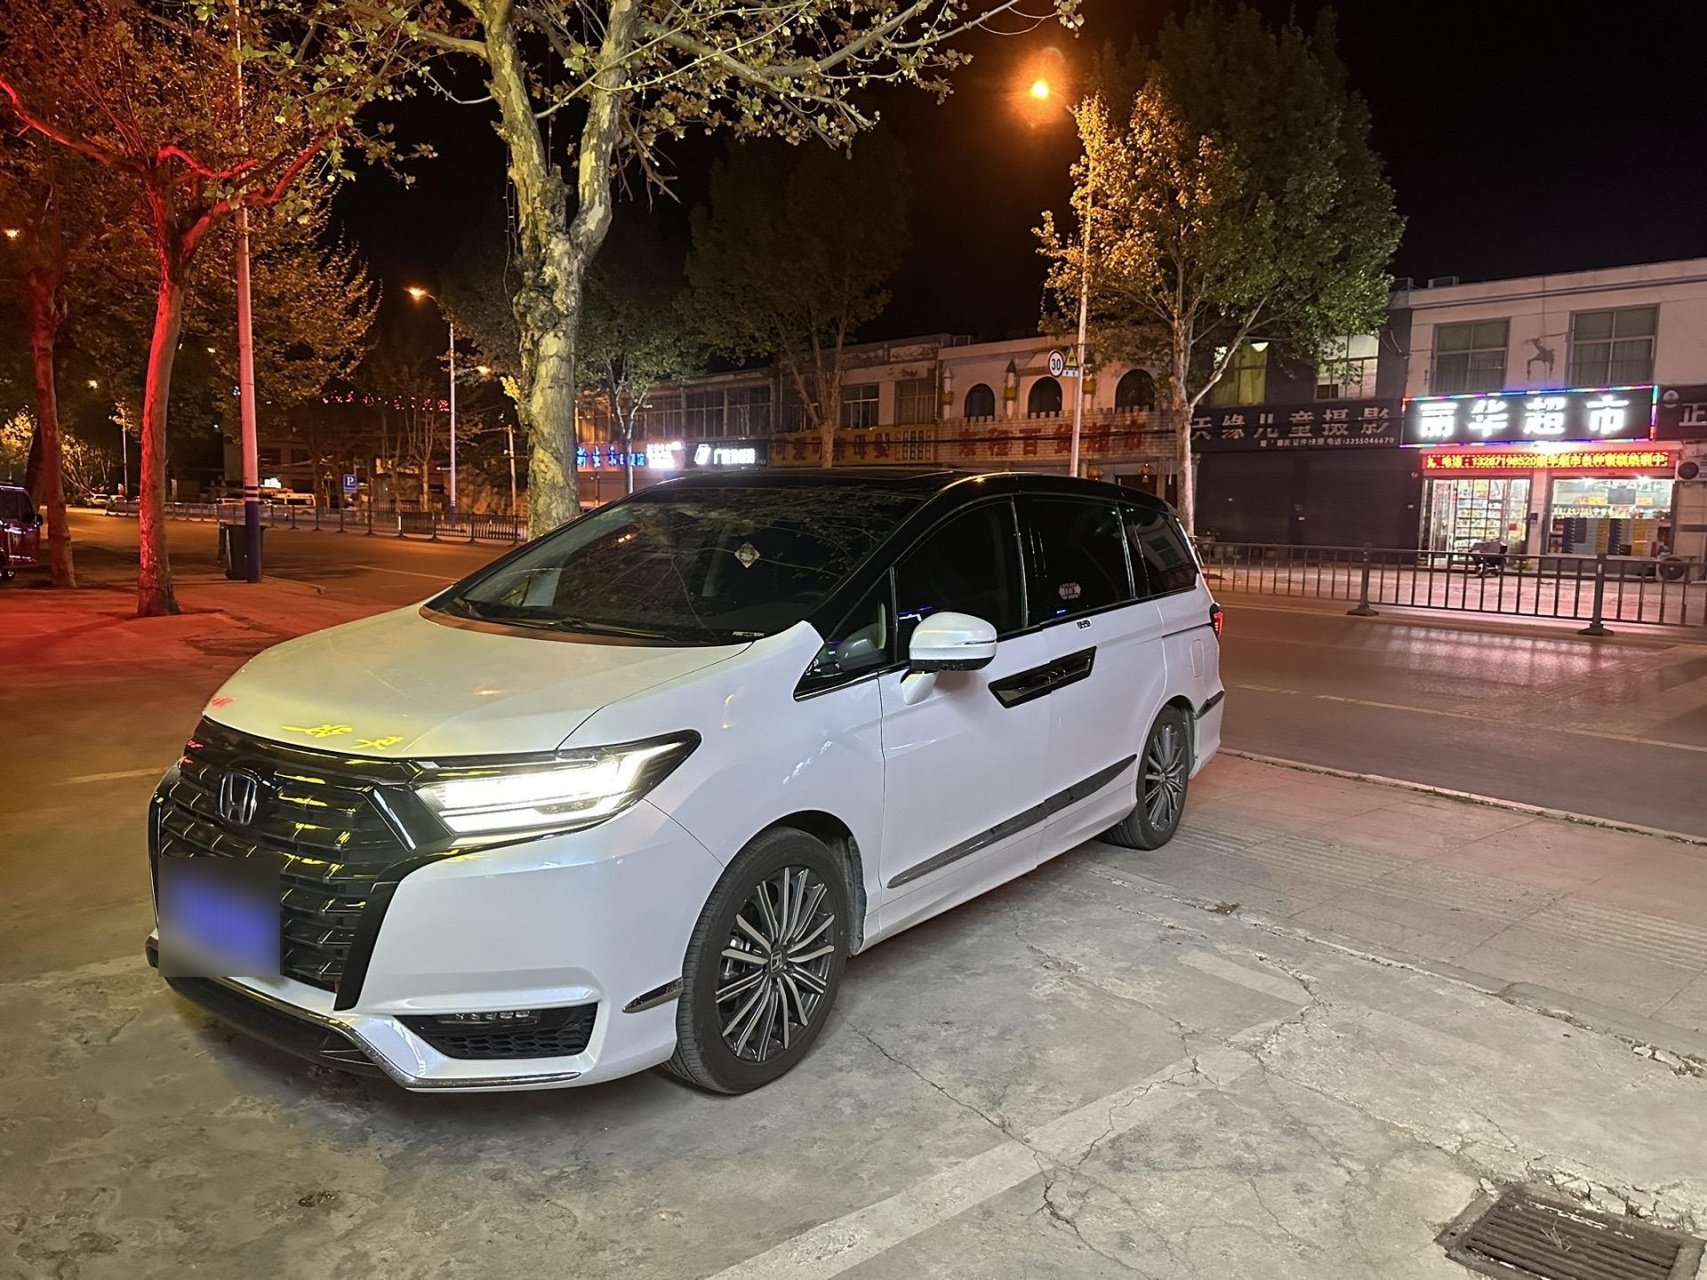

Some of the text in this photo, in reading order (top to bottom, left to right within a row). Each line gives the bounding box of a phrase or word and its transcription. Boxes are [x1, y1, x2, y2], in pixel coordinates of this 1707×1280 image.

[1051, 358, 1062, 371] 30
[1191, 408, 1390, 440] 天缘儿童摄影
[1420, 396, 1630, 437] 丽华超市
